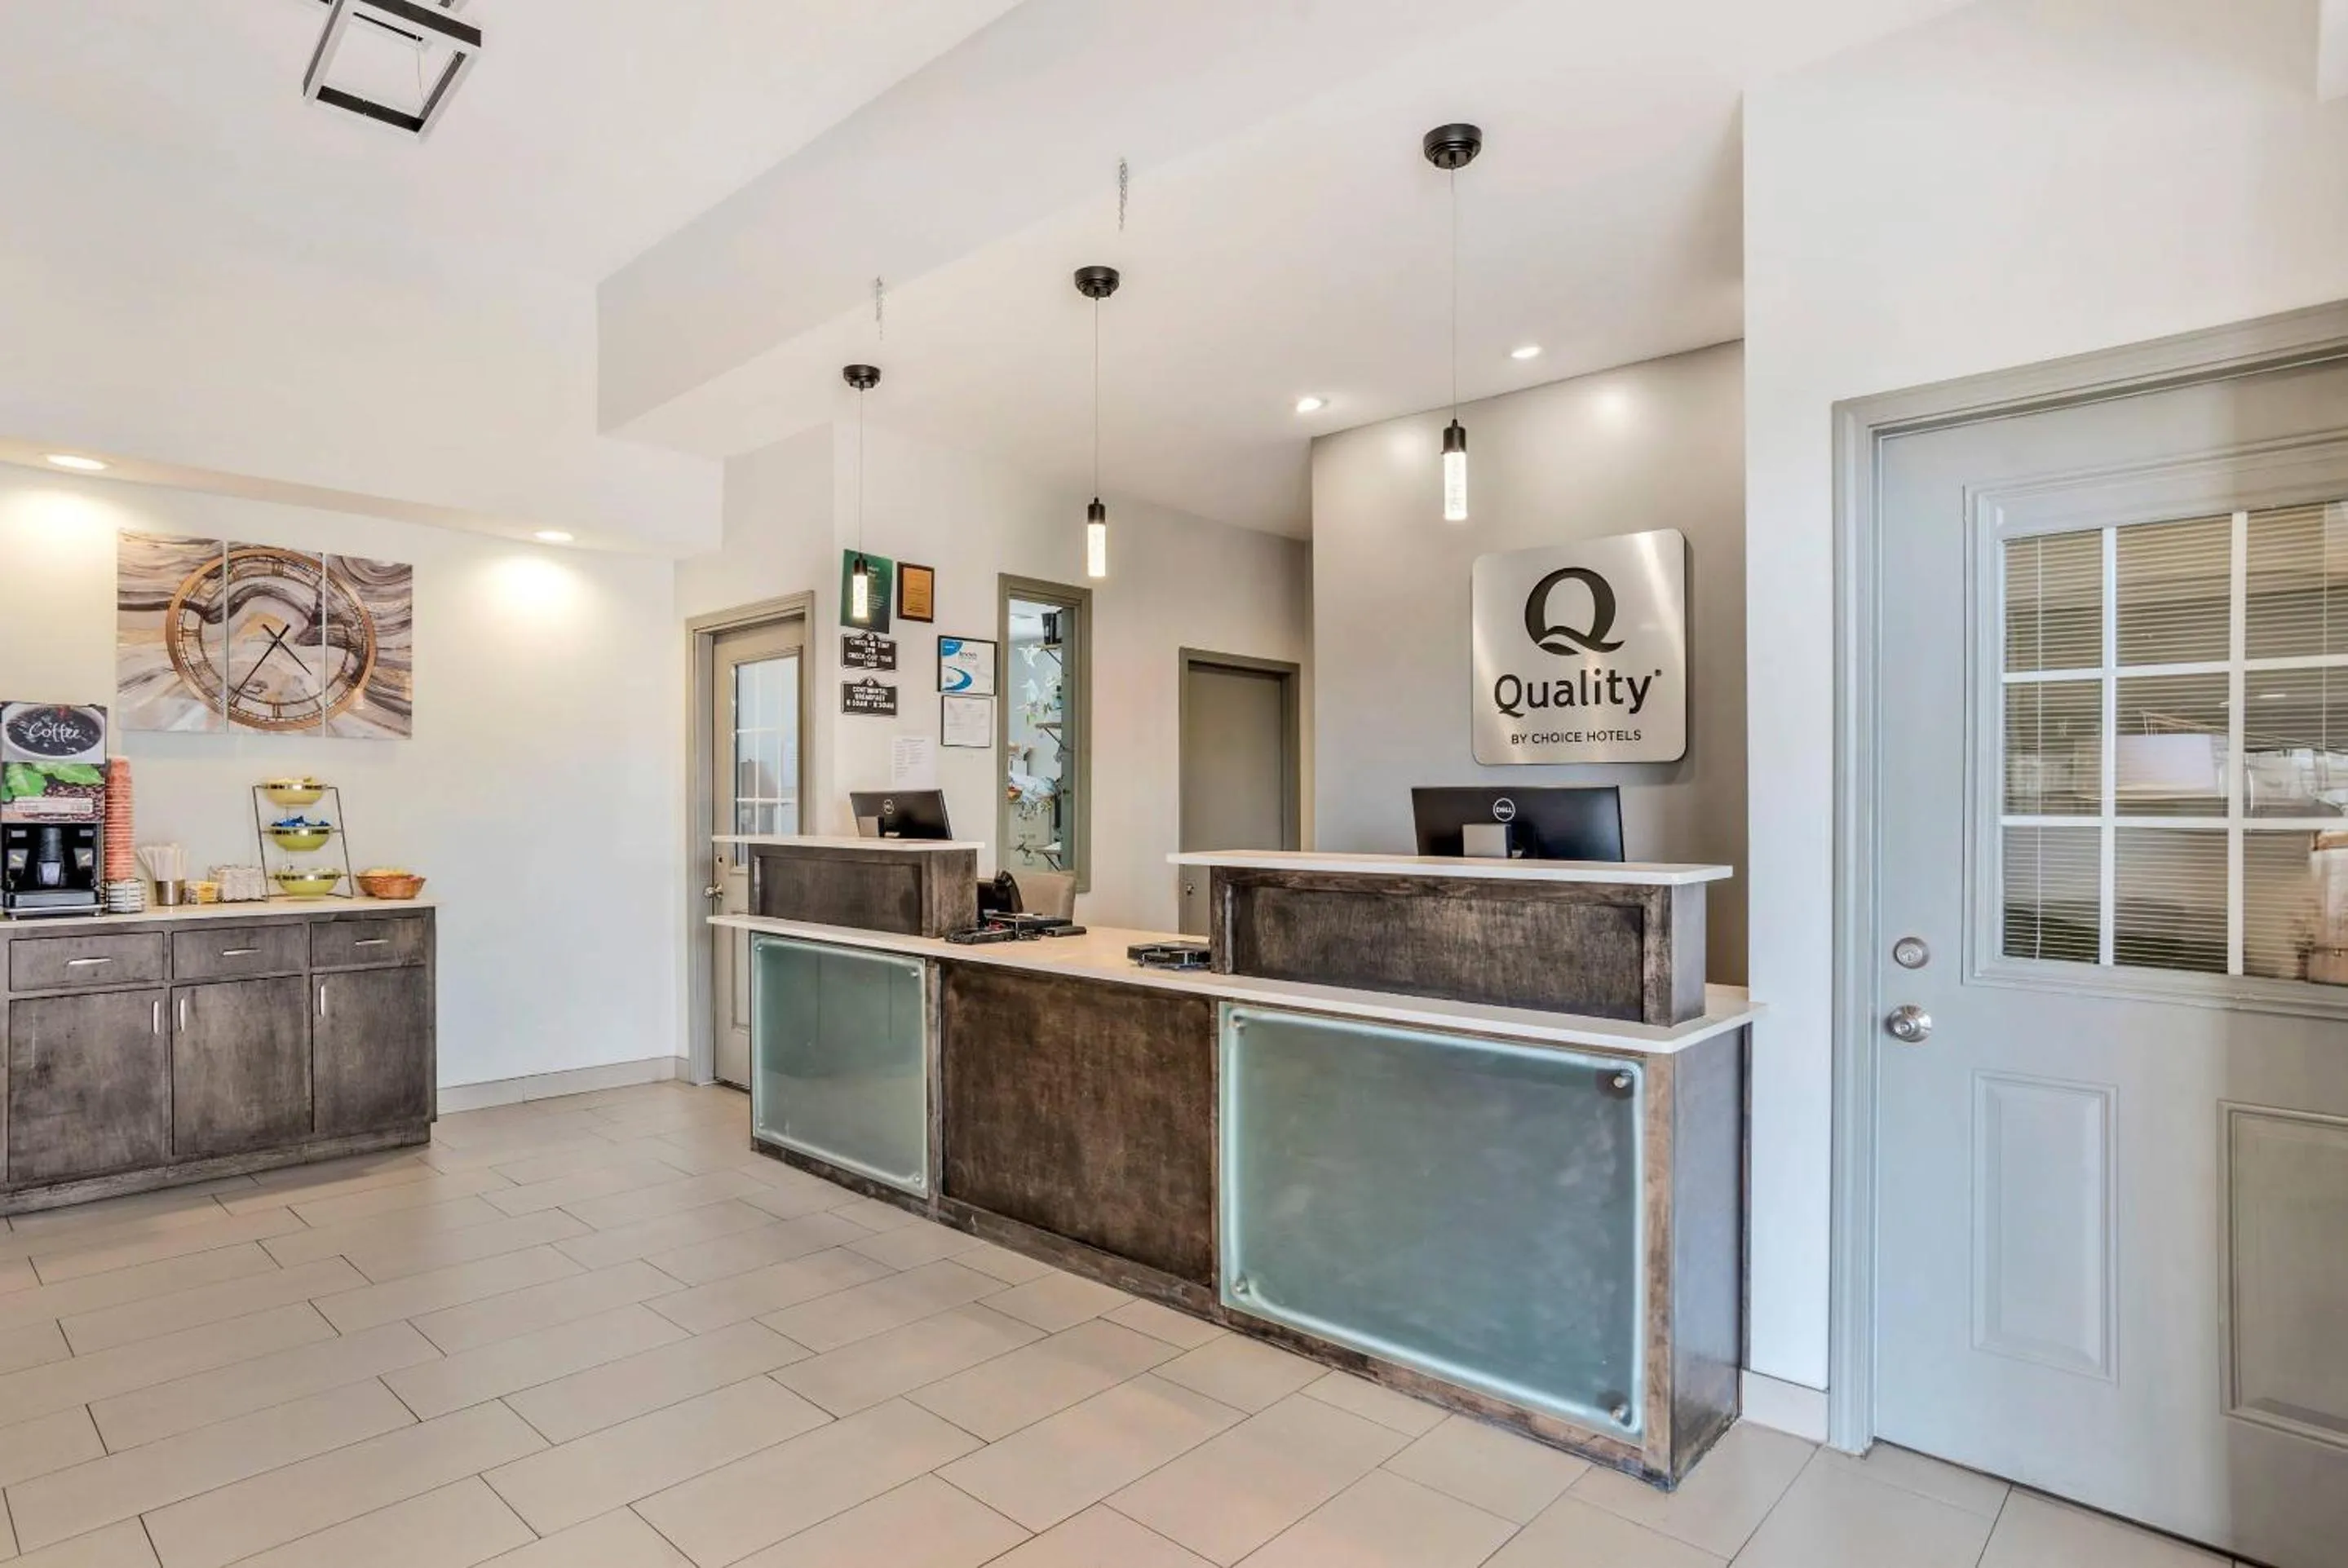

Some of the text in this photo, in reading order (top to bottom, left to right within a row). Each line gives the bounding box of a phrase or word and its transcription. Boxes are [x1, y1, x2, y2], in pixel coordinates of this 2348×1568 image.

[1524, 567, 1625, 656] Q
[1493, 668, 1652, 718] Quality
[29, 722, 81, 744] Coffee
[1511, 730, 1642, 744] BY CHOICE HOTELS
